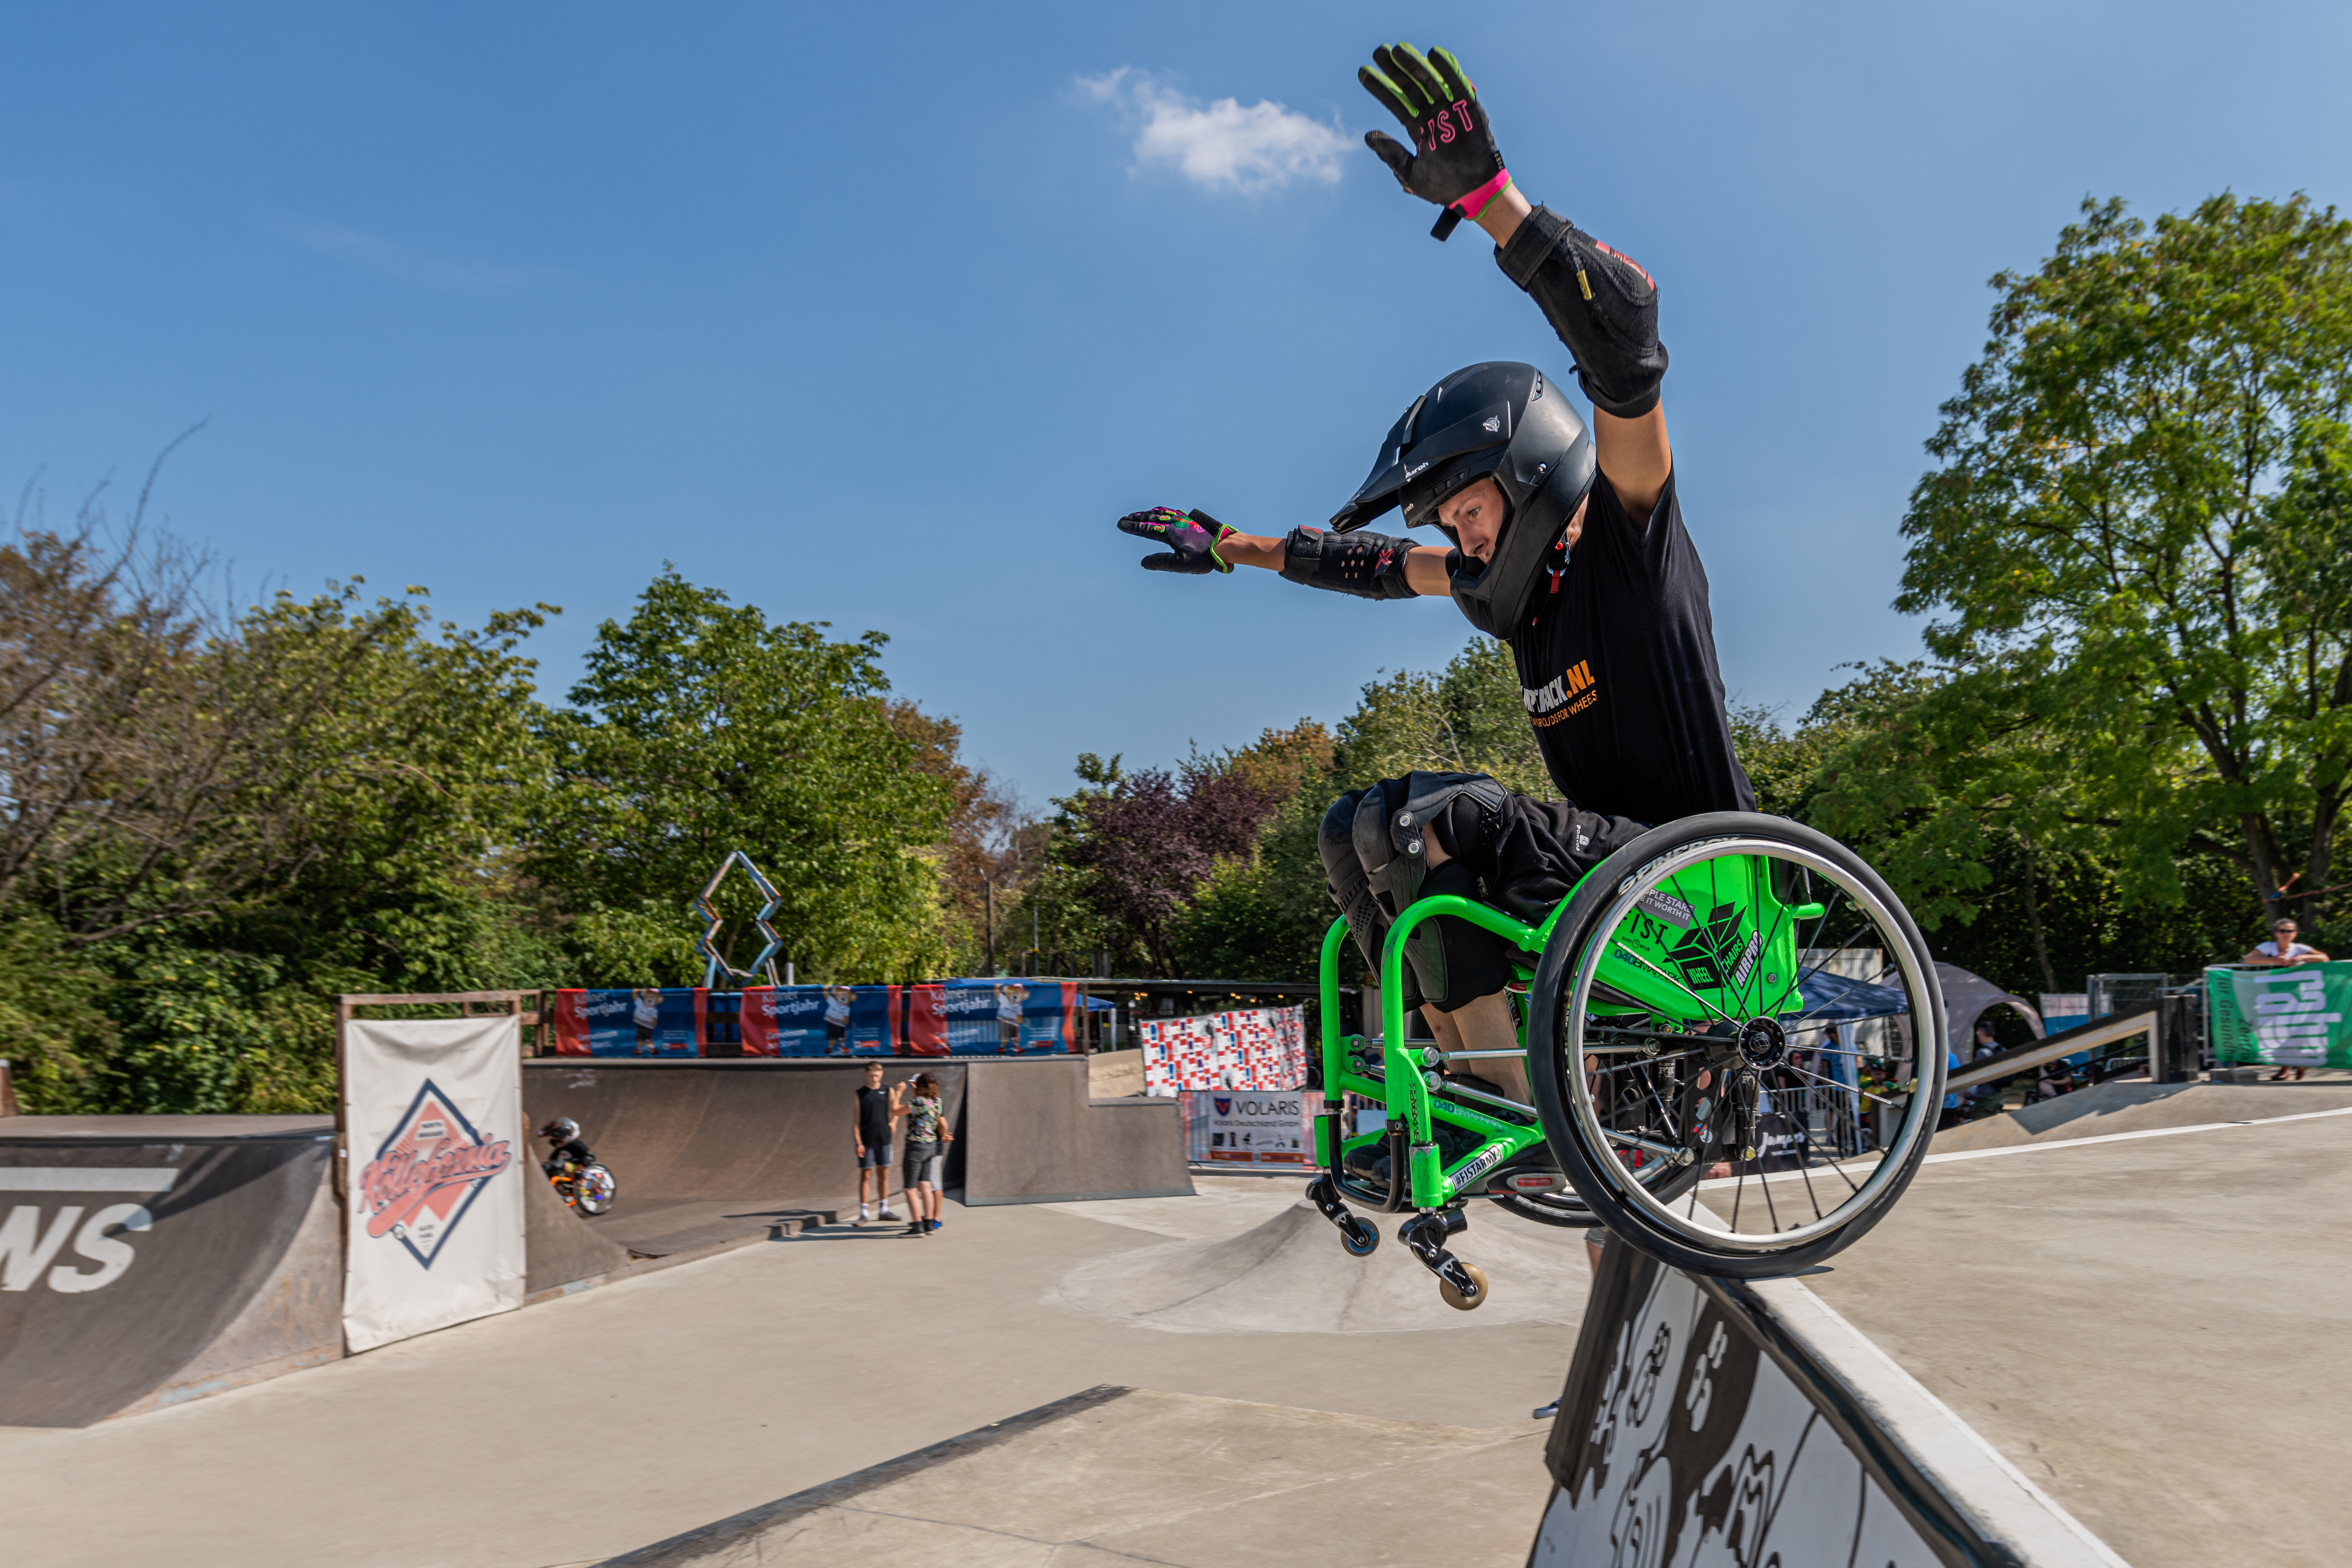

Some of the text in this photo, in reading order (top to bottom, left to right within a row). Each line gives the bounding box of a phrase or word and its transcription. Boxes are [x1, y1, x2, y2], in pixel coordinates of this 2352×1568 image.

[1405, 461, 1429, 479] Airoh
[1557, 708, 1569, 721] FOR
[1568, 690, 1597, 716] WHEES
[1654, 901, 1682, 917] WORTH
[1682, 913, 1691, 921] IT
[1665, 896, 1693, 913] STARE
[1621, 936, 1650, 952] HAND WEAR
[1721, 938, 1743, 973] CHAIRS
[1734, 930, 1763, 988] AIRPRO
[1686, 967, 1714, 985] WHEEL
[761, 998, 820, 1019] Sportjahr
[931, 997, 991, 1017] Sportjahr
[1659, 1067, 1674, 1077] FOX
[1742, 1075, 1756, 1086] FO
[1235, 1101, 1300, 1115] VOLARIS
[1455, 1150, 1497, 1187] #FISTARMY
[0, 1203, 153, 1294] NS
